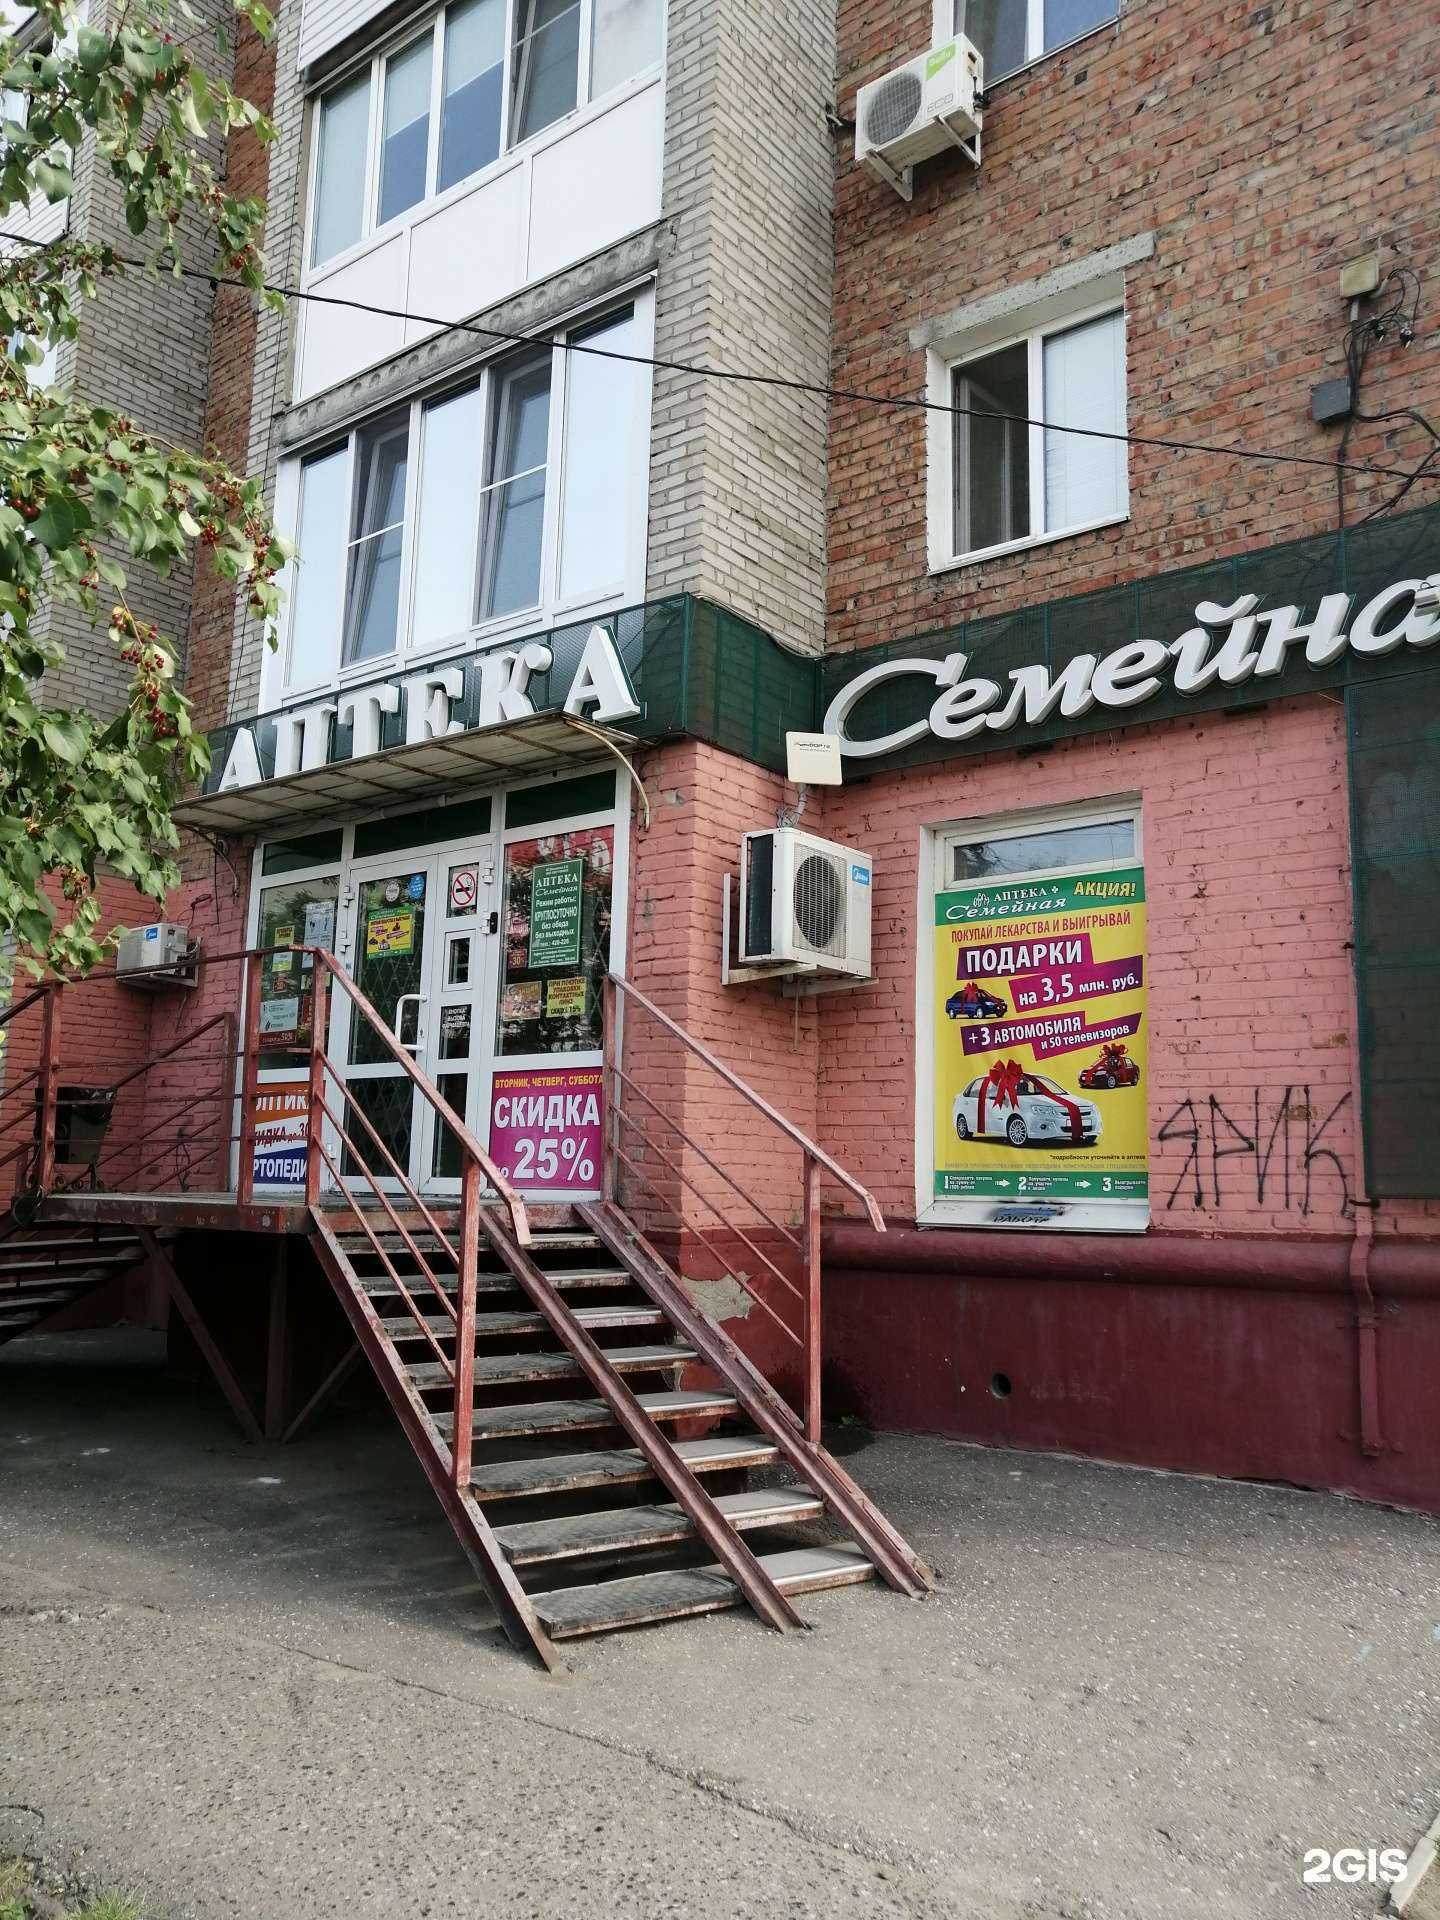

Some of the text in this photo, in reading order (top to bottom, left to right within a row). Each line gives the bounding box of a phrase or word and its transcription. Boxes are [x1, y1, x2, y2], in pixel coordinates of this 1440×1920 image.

[217, 625, 642, 793] АПТЕКА
[536, 873, 578, 888] АПТЕКА
[1074, 881, 1136, 899] АКЦИЯ!
[994, 887, 1047, 903] АПТЕКА
[535, 906, 578, 922] КРУГЛОСУТОЧНО
[946, 897, 1067, 920] Семейная
[951, 910, 1131, 943] ПОКУПАЙ ЛЕКАРСТВА И ВЫИГРЫВАЙ
[966, 940, 1082, 975] ПОДАРКИ
[1019, 972, 1139, 1006] на 3,5 млн. руб.
[994, 1016, 1082, 1043] АВТОМОБИЛЯ
[1041, 1024, 1130, 1051] и 50 телевизоров
[495, 1078, 531, 1089] ВТОРНИК,
[532, 1076, 568, 1087] ЧЕТВЕРГ,
[494, 1093, 601, 1133] СКИДКА
[512, 1137, 595, 1181] 25%
[1158, 1085, 1352, 1219] ЯРИК
[253, 1158, 309, 1181] РТОПЕДИ
[1018, 1176, 1028, 1191] 2
[1102, 1176, 1112, 1192] 3
